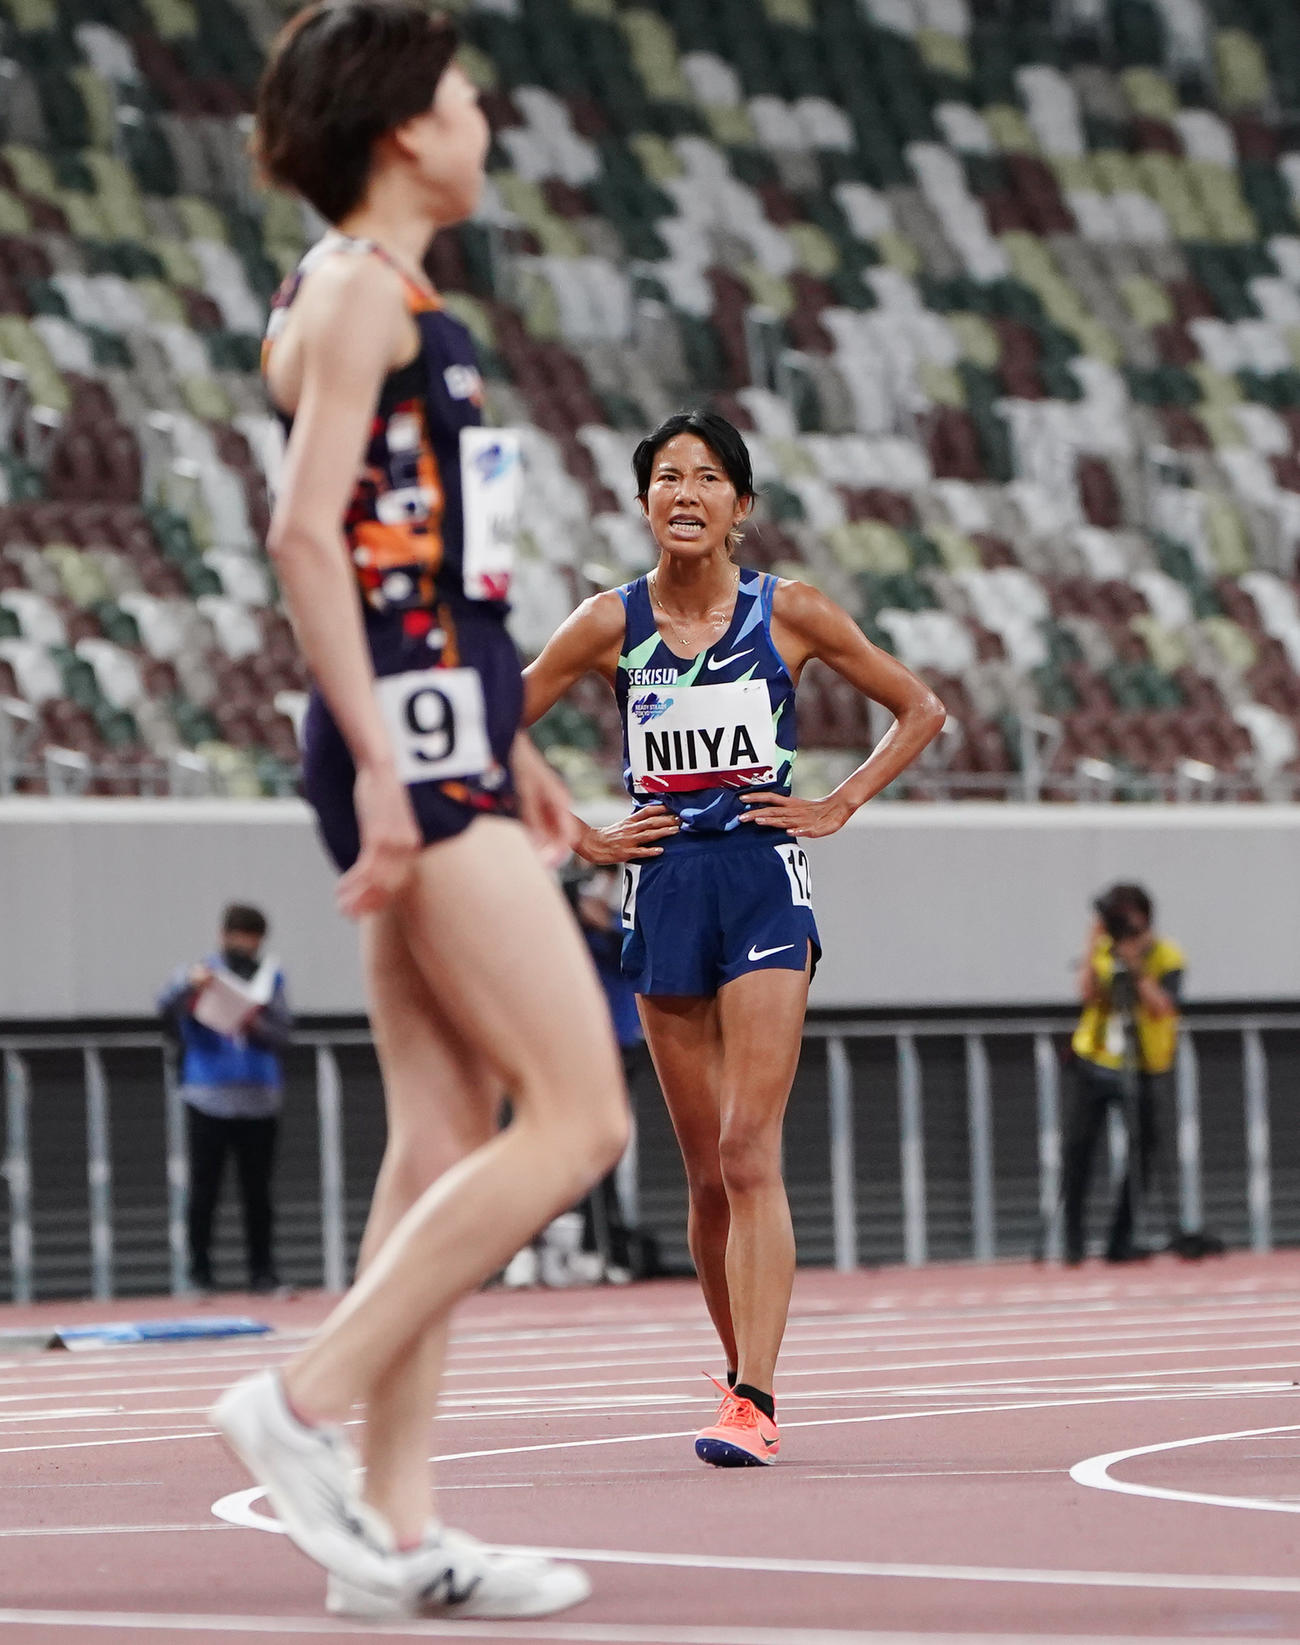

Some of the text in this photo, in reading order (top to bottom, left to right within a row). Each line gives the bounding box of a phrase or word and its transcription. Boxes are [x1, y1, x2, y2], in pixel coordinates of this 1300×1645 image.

[628, 668, 679, 685] SEKISUI
[404, 687, 456, 762] 9
[644, 724, 759, 772] NIIYA
